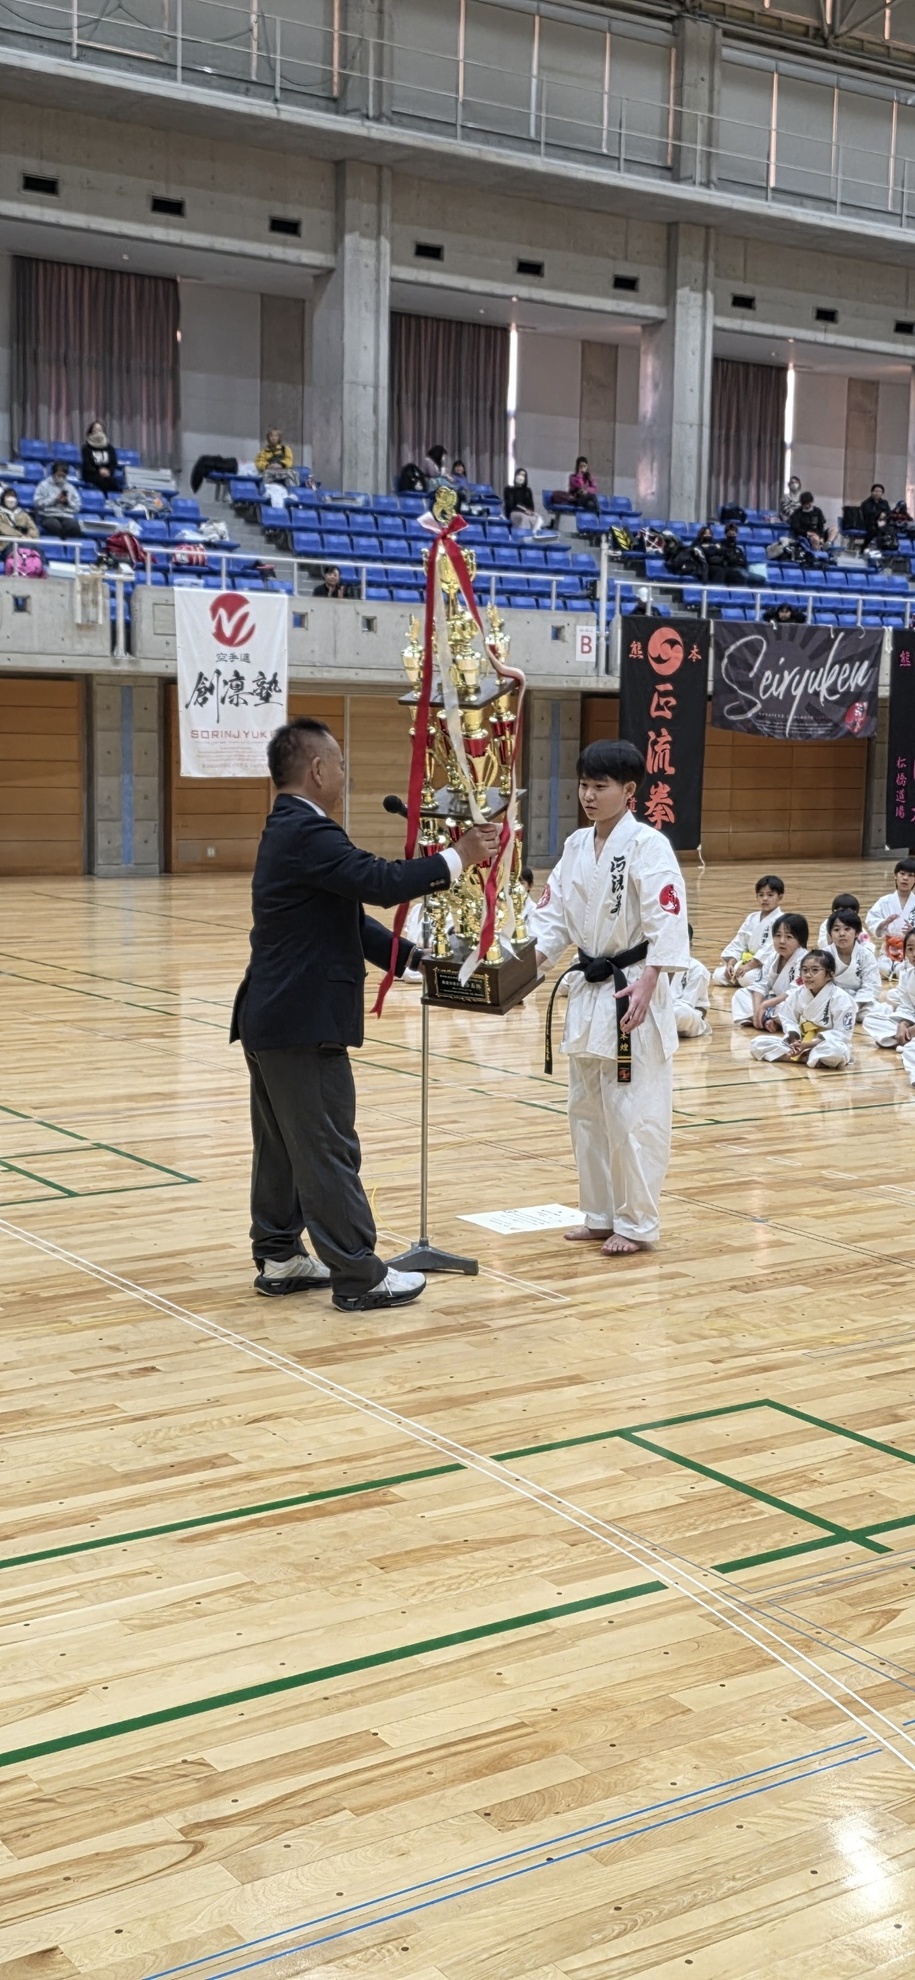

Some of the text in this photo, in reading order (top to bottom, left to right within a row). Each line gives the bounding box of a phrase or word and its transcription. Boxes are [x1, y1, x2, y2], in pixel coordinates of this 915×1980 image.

[581, 635, 592, 654] B
[629, 641, 702, 662] 熊 本
[216, 653, 251, 664] 空手道
[721, 632, 873, 737] Seiryuken
